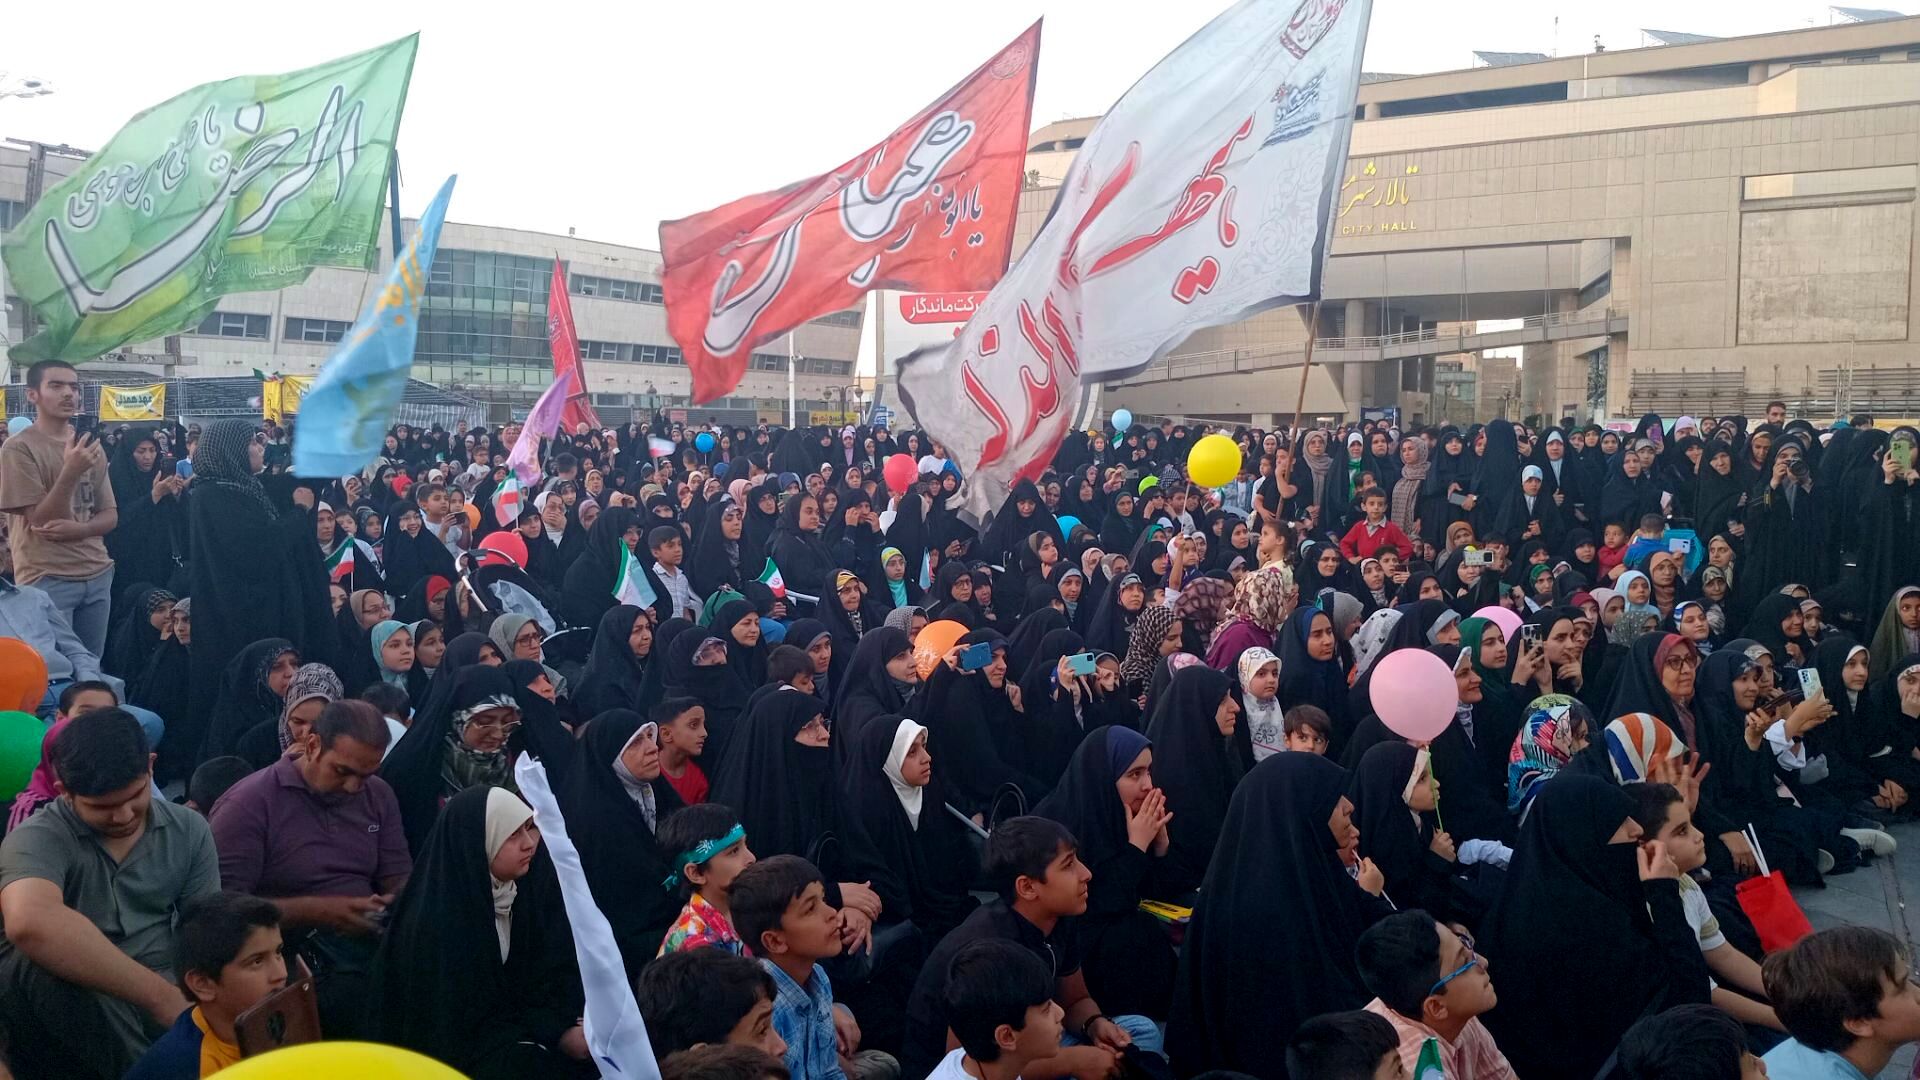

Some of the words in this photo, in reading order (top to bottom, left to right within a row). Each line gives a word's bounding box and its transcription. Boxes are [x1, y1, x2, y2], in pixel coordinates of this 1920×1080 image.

[1372, 165, 1419, 209] تالار
[1342, 224, 1374, 235] CITY
[1381, 220, 1417, 232] HALL
[908, 297, 953, 319] ماندگار
[953, 295, 980, 316] رکت
